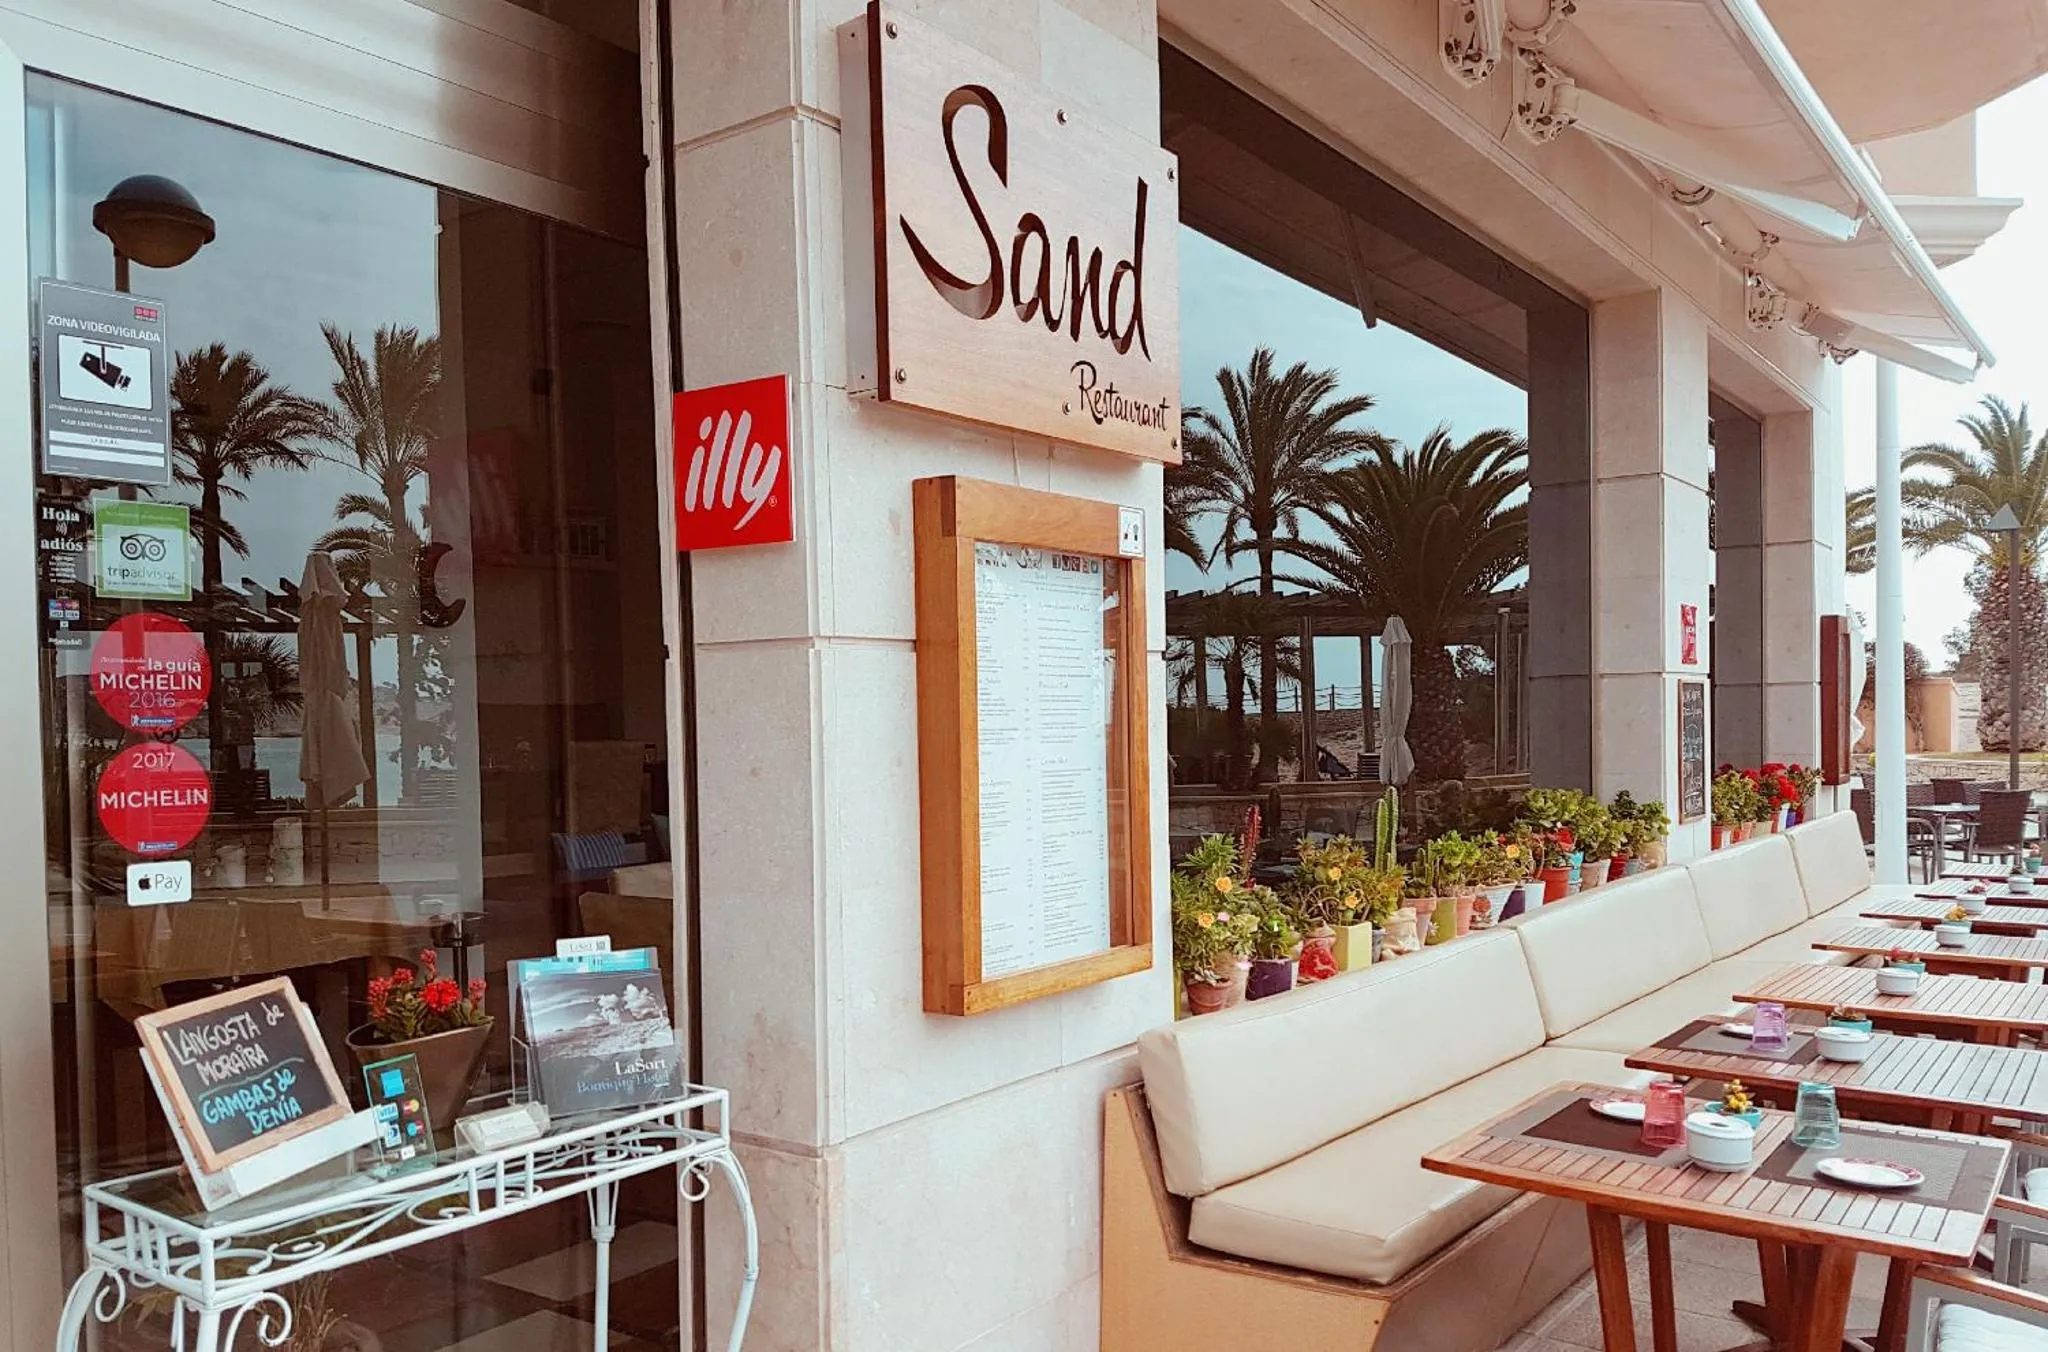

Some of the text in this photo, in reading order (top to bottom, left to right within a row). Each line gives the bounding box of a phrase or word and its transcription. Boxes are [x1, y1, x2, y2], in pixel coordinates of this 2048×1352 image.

[899, 84, 1151, 362] Sand
[47, 314, 161, 343] ZONA VIDEOVIGILADA
[1070, 360, 1171, 431] Restaurant
[685, 410, 782, 531] illy
[42, 506, 80, 522] Hola
[40, 537, 84, 552] adiós
[148, 658, 201, 674] la guía
[100, 672, 202, 691] MICHELIN
[129, 691, 176, 709] 2016
[132, 751, 176, 770] 2017
[100, 788, 208, 810] MICHELIN
[154, 873, 183, 893] Pay
[163, 1002, 285, 1066] LANGOSTA de
[202, 1067, 297, 1125] GAMBAS de
